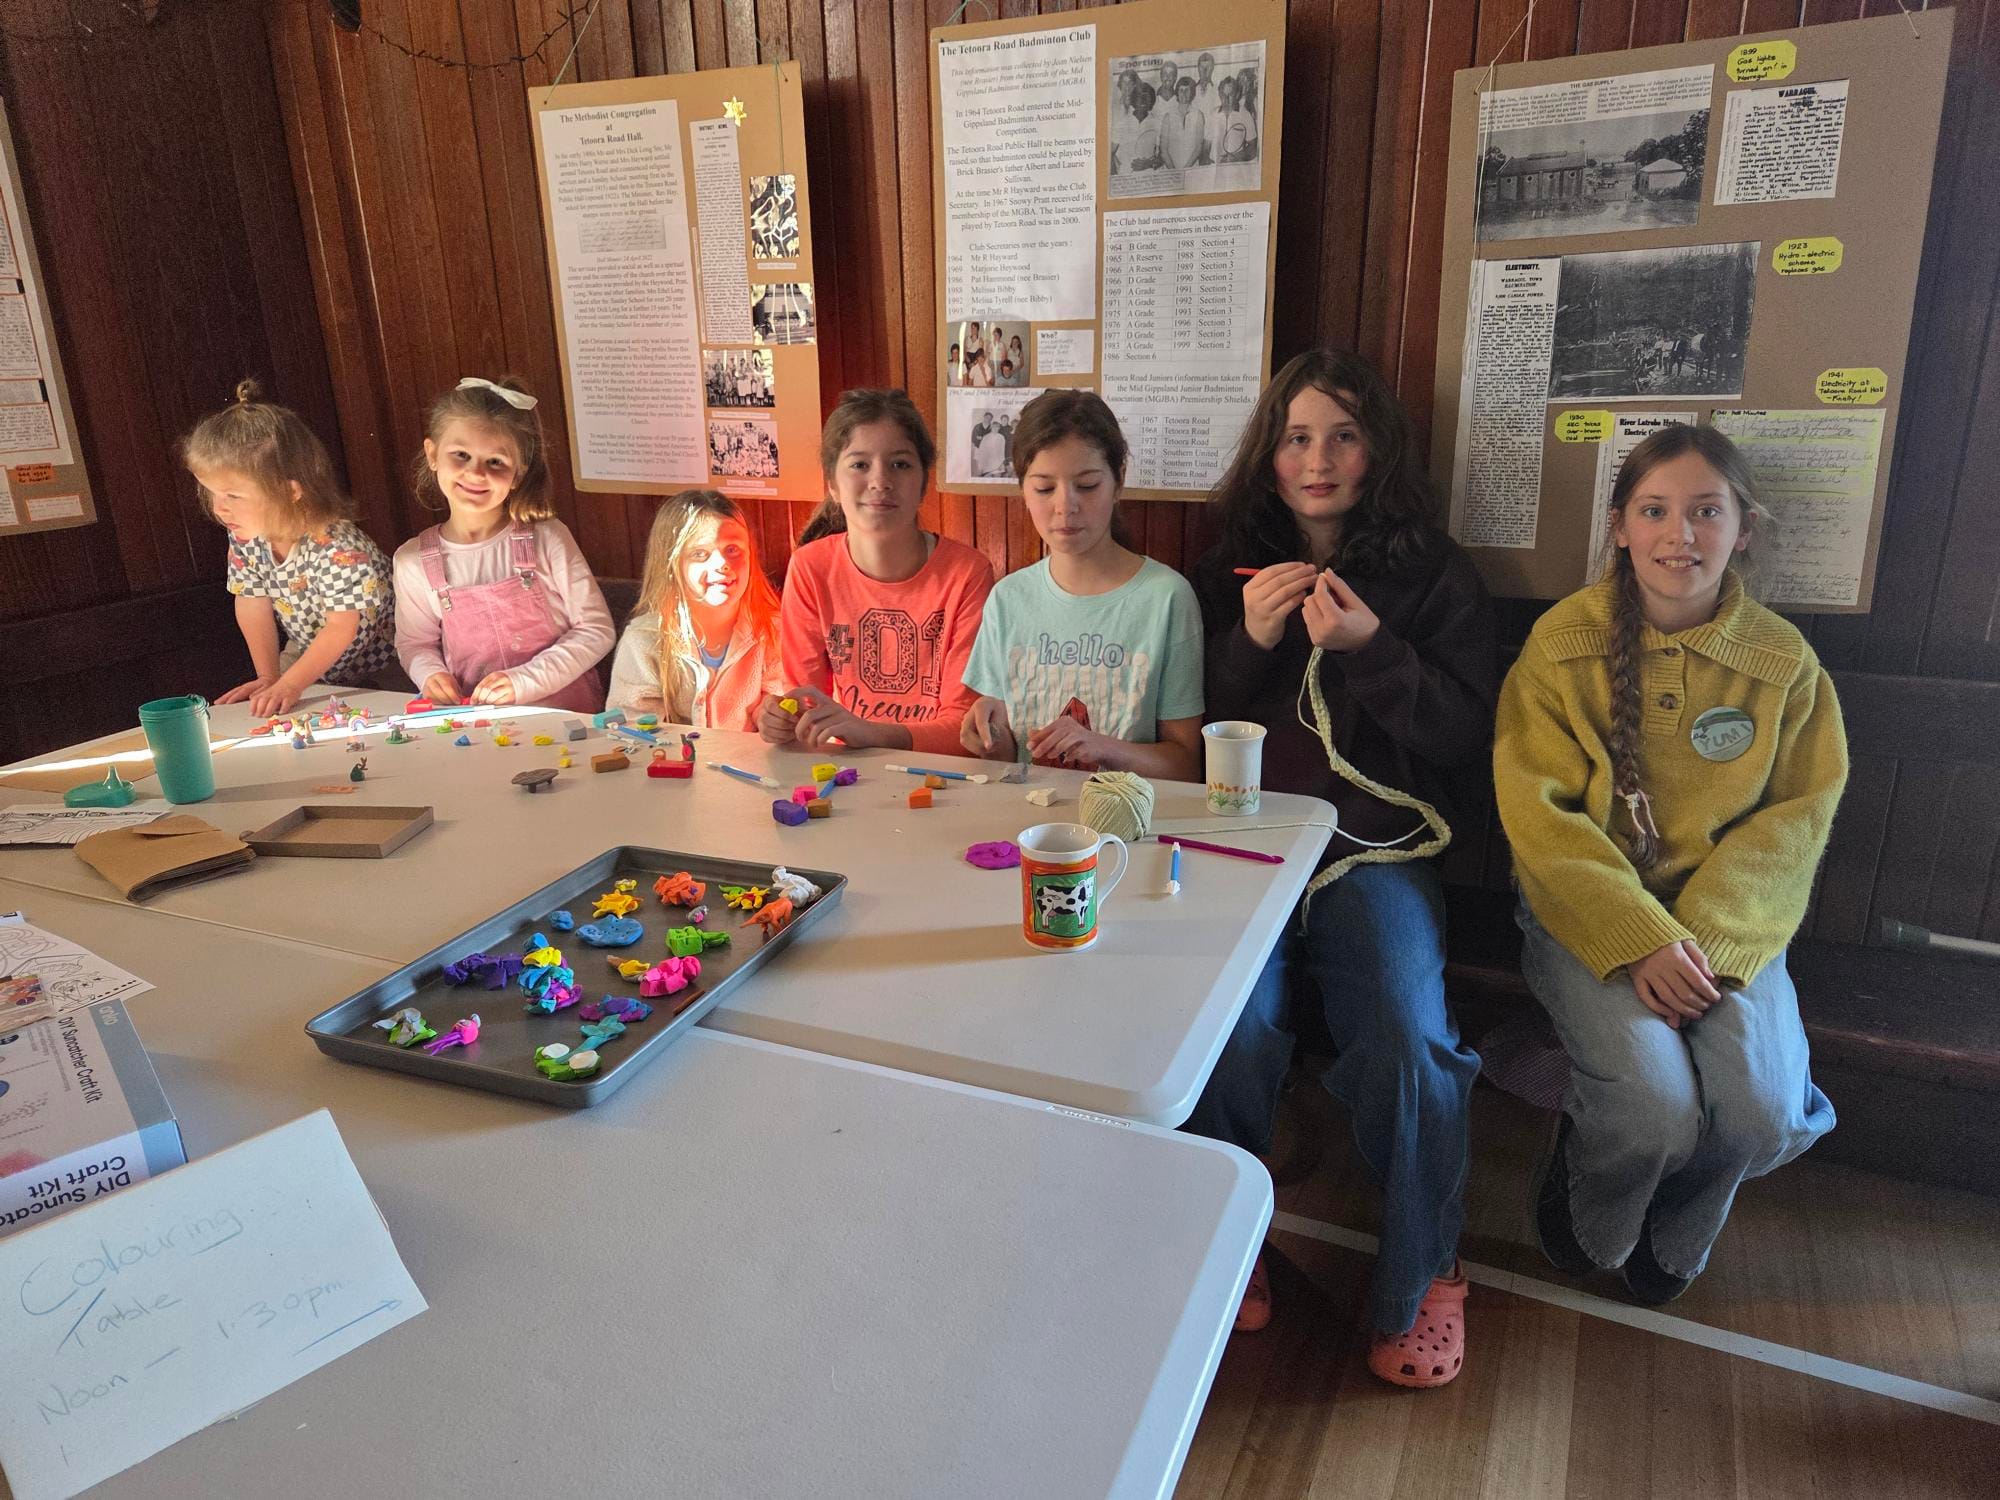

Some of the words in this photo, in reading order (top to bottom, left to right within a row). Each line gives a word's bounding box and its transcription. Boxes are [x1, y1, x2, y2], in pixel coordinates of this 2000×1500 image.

[941, 46, 957, 56] The
[959, 44, 991, 55] Tetoora
[994, 40, 1016, 51] Road
[1020, 34, 1067, 48] Badminton
[1069, 30, 1091, 42] Club
[1737, 57, 1753, 65] Gas
[1736, 66, 1758, 74] turned
[1007, 104, 1025, 112] Road
[1027, 102, 1052, 111] entered
[1054, 100, 1065, 109] the
[560, 115, 573, 123] The
[575, 111, 609, 122] Methodist
[610, 107, 657, 120] Congregation
[998, 116, 1033, 125] Badminton
[1036, 112, 1076, 122] Association
[580, 136, 605, 146] Tetoora
[607, 134, 625, 143] Road
[627, 132, 643, 142] Hall.
[1005, 141, 1025, 150] Public
[1027, 139, 1043, 148] Hall
[1054, 137, 1077, 146] beams
[1058, 148, 1082, 159] played
[1083, 148, 1092, 158] by
[1025, 163, 1047, 171] Albert
[1047, 162, 1060, 170] and
[1063, 161, 1085, 169] Laurie
[1010, 186, 1041, 196] Hayward
[1057, 184, 1068, 192] the
[1069, 182, 1087, 191] Club
[1082, 193, 1094, 202] life
[1040, 207, 1053, 215] The
[1055, 206, 1067, 214] last
[1018, 218, 1037, 227] Road
[1061, 216, 1081, 225] 2000.
[1105, 218, 1118, 227] The
[1119, 217, 1137, 226] Club
[1137, 217, 1150, 225] had
[1151, 216, 1186, 224] numerous
[1188, 214, 1222, 222] successes
[1109, 230, 1127, 240] years
[1128, 229, 1141, 237] and
[1161, 226, 1193, 235] Premiers
[1203, 224, 1222, 233] these
[1223, 224, 1243, 233] years
[1105, 243, 1122, 251] 1964
[1136, 242, 1157, 250] Grade
[1177, 240, 1194, 248] 1988
[1201, 239, 1228, 247] Section
[1136, 253, 1163, 262] Reserve
[1177, 252, 1194, 260] 1988
[1200, 250, 1227, 259] Section
[1778, 251, 1800, 261] Hydro
[1807, 249, 1835, 258] electric
[1176, 263, 1194, 271] 1989
[1200, 262, 1227, 270] Section
[1811, 265, 1826, 273] gas
[1200, 273, 1227, 282] Section
[1199, 296, 1226, 305] Section
[1173, 341, 1190, 349] 1999
[1198, 341, 1224, 349] Section
[1130, 373, 1148, 382] Road
[1149, 374, 1174, 382] Juniors
[1220, 374, 1241, 382] taken
[1243, 374, 1260, 382] from
[1820, 380, 1857, 388] Electricity
[1142, 416, 1158, 424] 1967
[1164, 416, 1189, 425] Tetoora
[1191, 416, 1210, 425] Road
[1619, 418, 1636, 426] River
[1637, 418, 1661, 426] Latrobe
[1162, 449, 1193, 457] Southern
[1195, 450, 1219, 458] United
[1039, 632, 1125, 669] hello
[58, 1016, 76, 1030] DIY
[62, 1029, 88, 1069] Suncatcher
[77, 1069, 98, 1092] Craft
[84, 1088, 103, 1104] Kit
[66, 1156, 126, 1185] Craft
[28, 1177, 61, 1198] Kit
[95, 1171, 131, 1197] DIY
[20, 1207, 244, 1317] Colouring
[57, 1287, 184, 1349] Table
[37, 1373, 129, 1426] Noon
